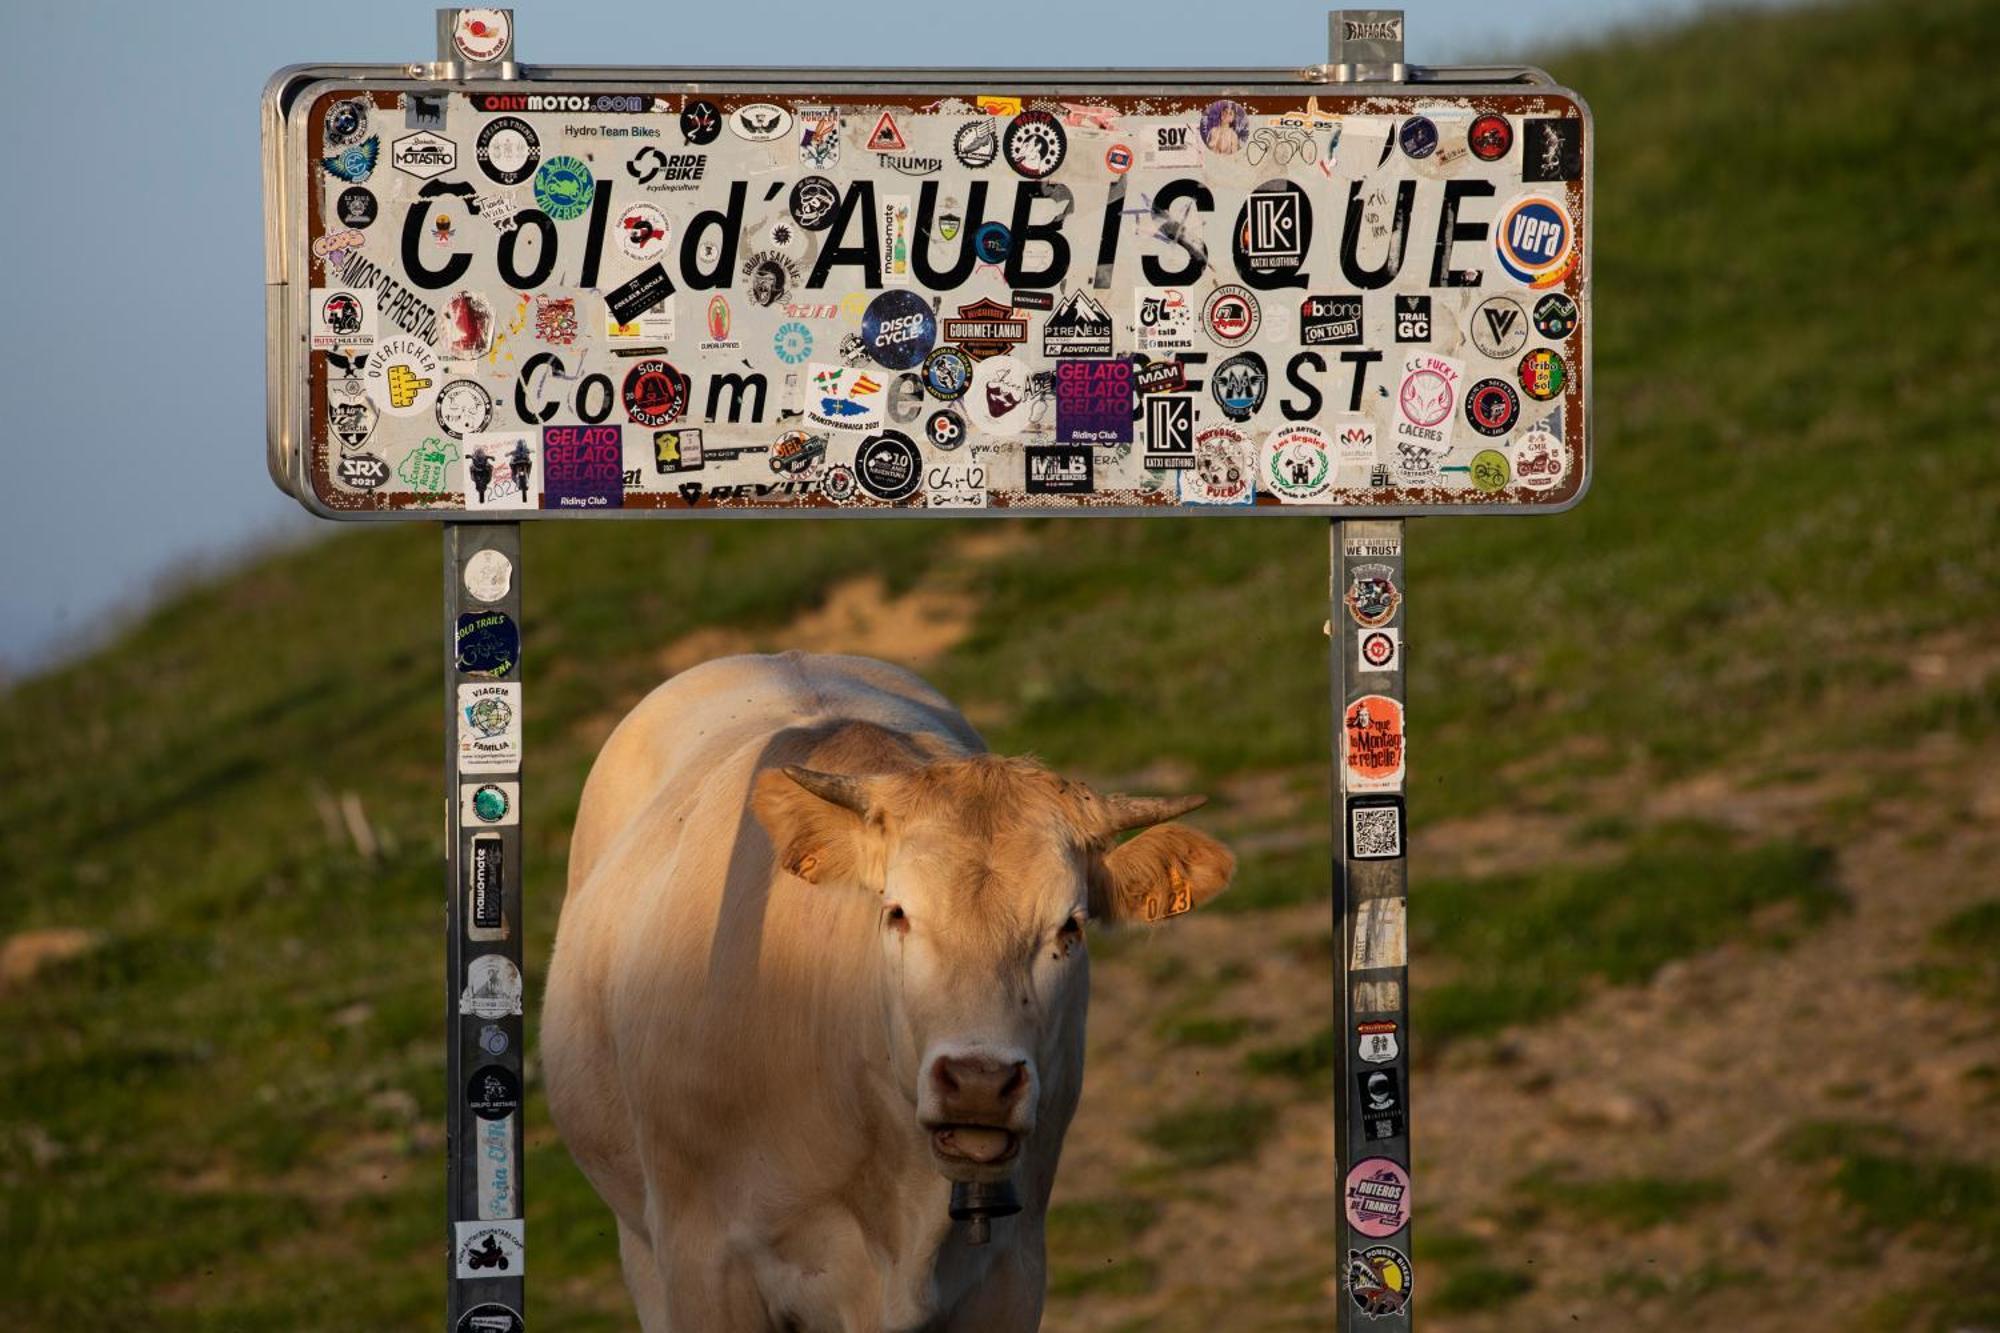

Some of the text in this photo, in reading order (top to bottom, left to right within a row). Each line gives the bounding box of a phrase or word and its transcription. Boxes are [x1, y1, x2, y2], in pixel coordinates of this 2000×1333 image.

[564, 124, 661, 137] Hydro Team Bikes
[1157, 127, 1187, 146] SOY
[668, 154, 708, 168] RIDE
[664, 167, 704, 181] BIKE
[401, 178, 612, 291] Col
[1511, 213, 1562, 257] vera
[879, 312, 924, 334] DISCO
[1398, 312, 1428, 321] TRAIL
[875, 327, 919, 348] CYCLE
[1309, 323, 1354, 340] ON TOUR
[1398, 322, 1429, 338] GC
[1062, 344, 1110, 353] ADVENTURE
[1058, 363, 1130, 379] GELATO
[1528, 358, 1557, 371] tribo
[1138, 365, 1179, 385] MAM
[1536, 372, 1549, 381] do
[1058, 381, 1130, 397] GELATO
[1533, 381, 1551, 390] sol
[1058, 399, 1130, 415] GELATO
[545, 428, 619, 446] GELATO
[1071, 430, 1118, 441] Riding Club
[1398, 422, 1444, 441] CACERES
[545, 446, 619, 463] GELATO
[892, 452, 908, 467] 10
[343, 460, 384, 477] SRX
[545, 464, 619, 481] GELATO
[1031, 456, 1088, 474] MLB
[351, 478, 376, 486] 2021
[560, 496, 608, 507] Riding Club
[1346, 546, 1398, 556] WE TRUST
[473, 741, 510, 752] FAMILIA
